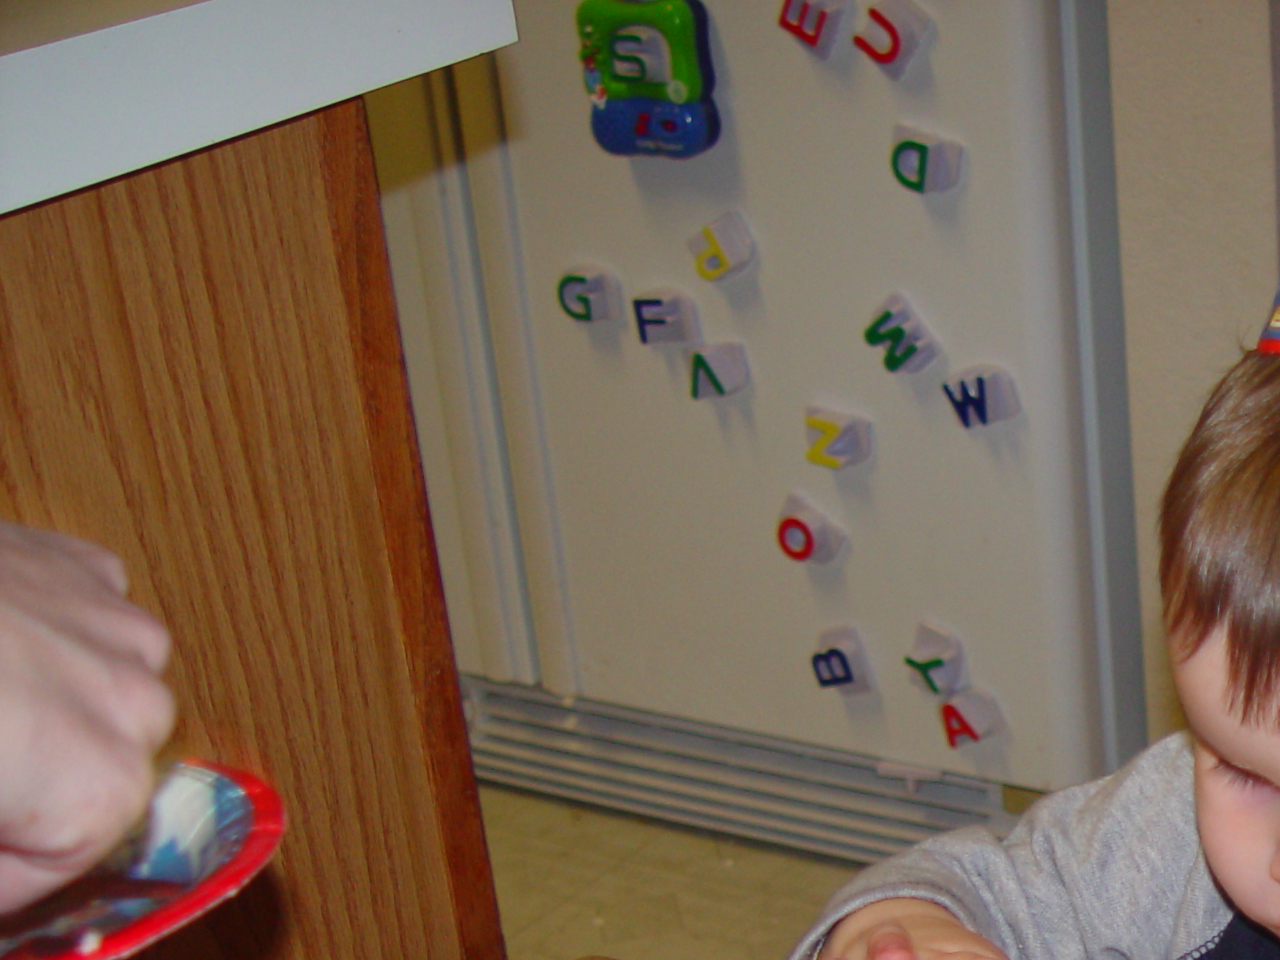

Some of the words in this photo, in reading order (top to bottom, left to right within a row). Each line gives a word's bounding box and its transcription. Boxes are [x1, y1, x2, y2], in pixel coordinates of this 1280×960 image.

[610, 33, 647, 83] S
[853, 7, 902, 64] U
[890, 139, 929, 194] D
[557, 274, 592, 322] G
[632, 298, 667, 344] F
[941, 376, 988, 429] W
[777, 517, 815, 562] O
[811, 645, 854, 689] B
[904, 655, 944, 695] Y
[940, 701, 981, 749] A
